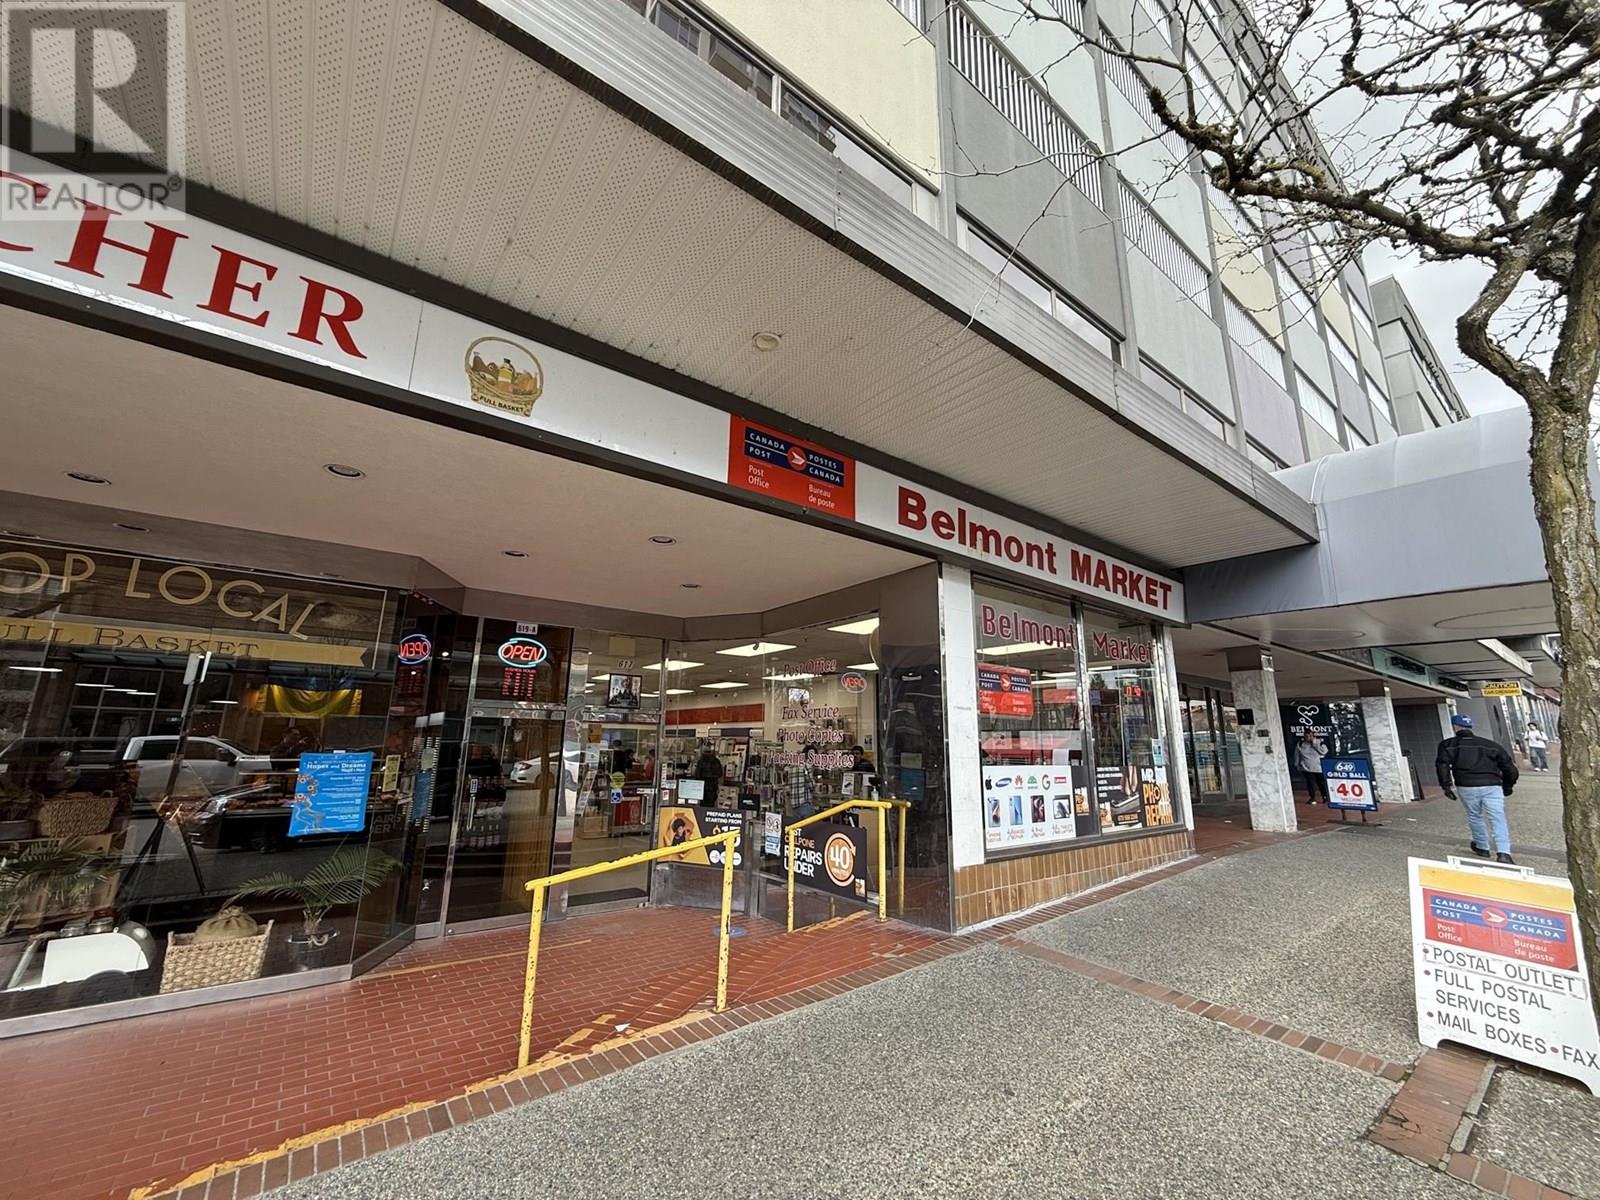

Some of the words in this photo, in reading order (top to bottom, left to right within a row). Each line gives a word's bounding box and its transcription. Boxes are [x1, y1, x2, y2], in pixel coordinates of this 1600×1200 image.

[480, 396, 497, 407] FULL
[498, 403, 523, 412] BASKET
[749, 432, 785, 450] CANADA
[749, 446, 770, 459] POST
[809, 454, 837, 469] POSTES
[748, 465, 764, 477] Post
[809, 467, 841, 483] CANADA
[748, 475, 769, 489] Office
[808, 484, 831, 498] Bureau
[808, 494, 816, 505] de
[817, 497, 835, 509] poste
[898, 485, 1057, 575] Belmont
[1070, 548, 1172, 610] MARKET
[0, 551, 96, 594] OP
[125, 558, 315, 640] LOCAL
[92, 626, 261, 657] BASKET
[981, 604, 1077, 651] Belmont
[1092, 630, 1155, 665] Market
[502, 644, 542, 661] OPEN
[783, 661, 804, 676] Post
[805, 657, 837, 674] Office
[782, 706, 799, 720] Fax
[801, 704, 839, 720] Service
[776, 728, 804, 744] Photo
[807, 726, 845, 745] Copies
[767, 750, 806, 768] Packing
[807, 749, 855, 771] Supplies
[784, 845, 823, 866] RPAIRS
[830, 845, 850, 870] 40
[1435, 898, 1478, 912] CANADA
[1436, 909, 1462, 919] POST
[1511, 912, 1553, 926] POSTES
[1437, 923, 1455, 934] Post
[1512, 924, 1561, 940] CANADA
[1437, 931, 1463, 943] Office
[1514, 938, 1548, 952] Bureau
[1514, 947, 1527, 957] de
[1529, 951, 1556, 963] poste
[1433, 947, 1497, 974] POSTAL
[1504, 963, 1575, 992] OUTLET
[1434, 969, 1474, 991] FULL
[1482, 980, 1551, 1010] POSTAL
[1435, 989, 1521, 1025] SERVICES
[1437, 1011, 1477, 1034] MAIL
[1485, 1024, 1547, 1055] BOXES
[1562, 1045, 1600, 1071] FAX
